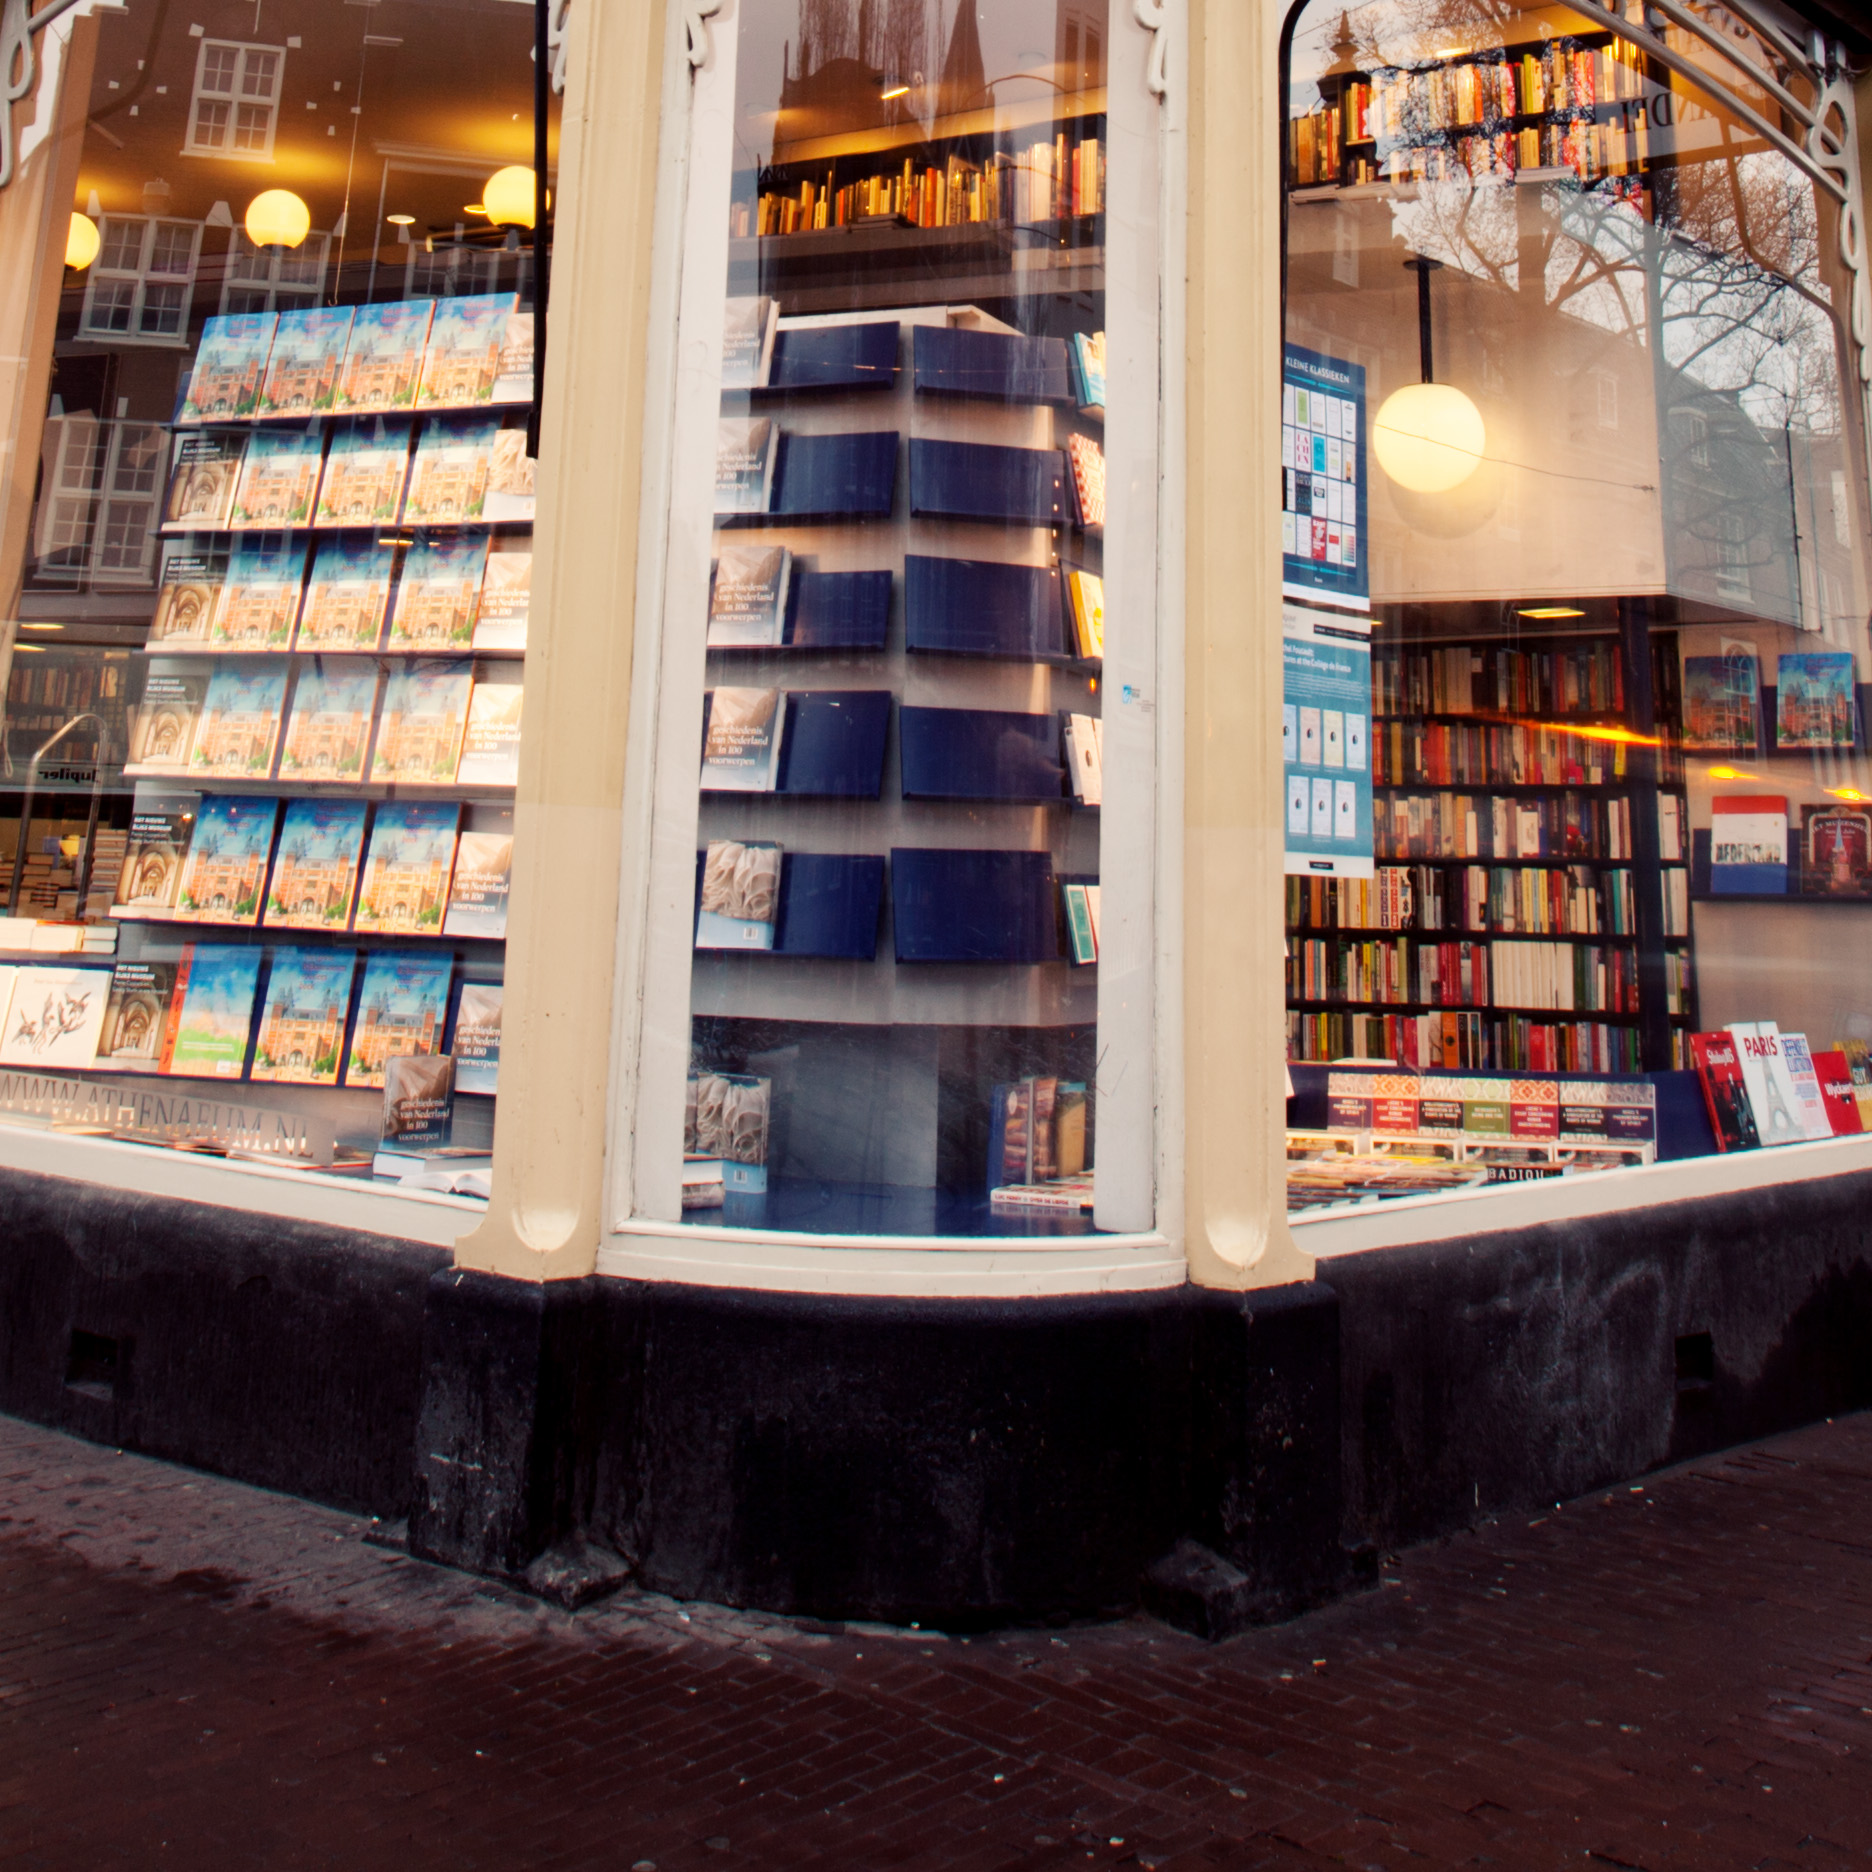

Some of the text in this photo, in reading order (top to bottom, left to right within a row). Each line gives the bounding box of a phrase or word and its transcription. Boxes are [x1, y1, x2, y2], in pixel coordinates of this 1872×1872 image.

[1286, 356, 1350, 384] KLEINE KLASSIEKEN
[734, 592, 774, 602] Nederland
[735, 603, 749, 611] 100
[728, 735, 768, 746] Nederland
[729, 746, 742, 755] 100
[471, 881, 509, 892] Nederland
[472, 892, 484, 900] 100
[459, 1025, 500, 1038] geschieden
[1743, 1035, 1778, 1057] PARIS
[414, 1108, 449, 1118] Nederland
